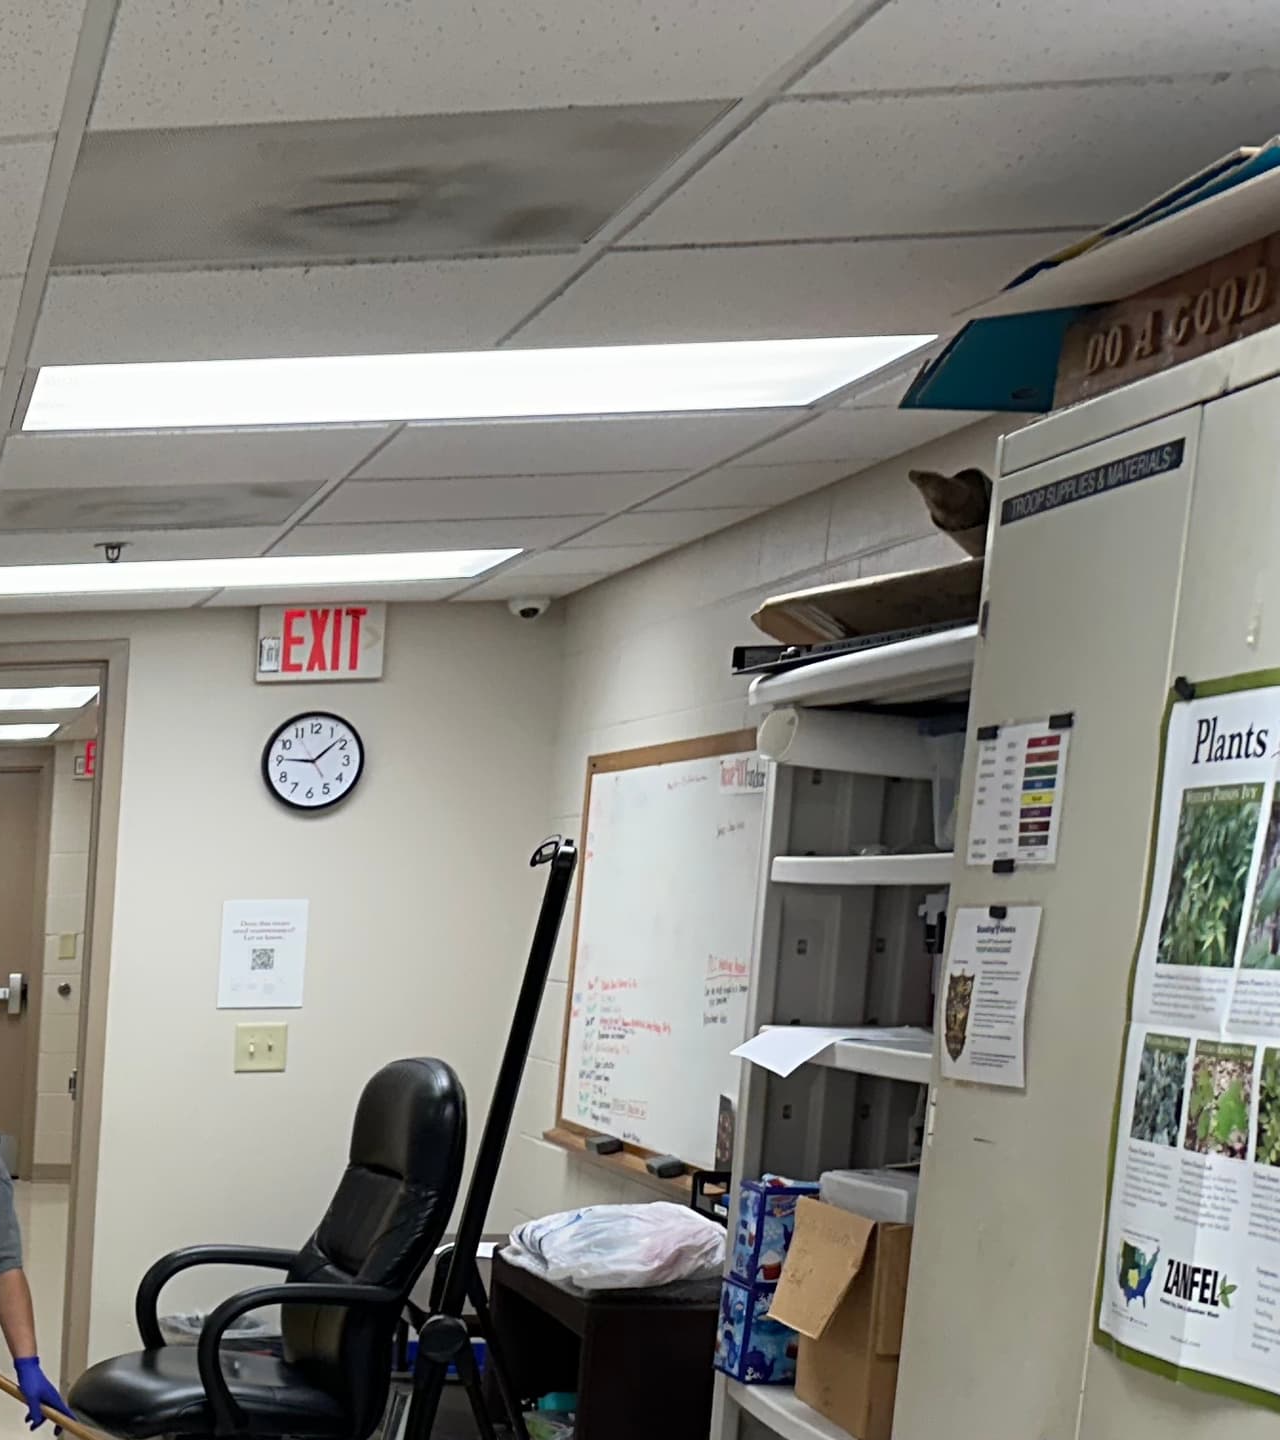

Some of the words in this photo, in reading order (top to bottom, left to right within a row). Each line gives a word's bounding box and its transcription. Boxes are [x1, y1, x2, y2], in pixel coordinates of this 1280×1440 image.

[1169, 268, 1267, 342] GOOD
[1011, 491, 1045, 519] TROOP
[1045, 471, 1096, 508] SUPPLIES
[1097, 471, 1105, 489] &
[1106, 446, 1172, 486] MATERIALS
[281, 606, 368, 672] EXIT
[295, 727, 304, 739] 11
[311, 722, 322, 734] 12
[281, 739, 292, 751] 10
[339, 739, 348, 751] 2
[1192, 716, 1269, 764] Plants
[276, 754, 284, 767] 9
[342, 754, 350, 767] 3
[279, 771, 288, 783] 8
[335, 772, 343, 784] 4
[290, 782, 299, 794] 7
[305, 787, 314, 799] 6
[322, 783, 330, 795] 5
[1163, 1259, 1219, 1307] ZANFEL
